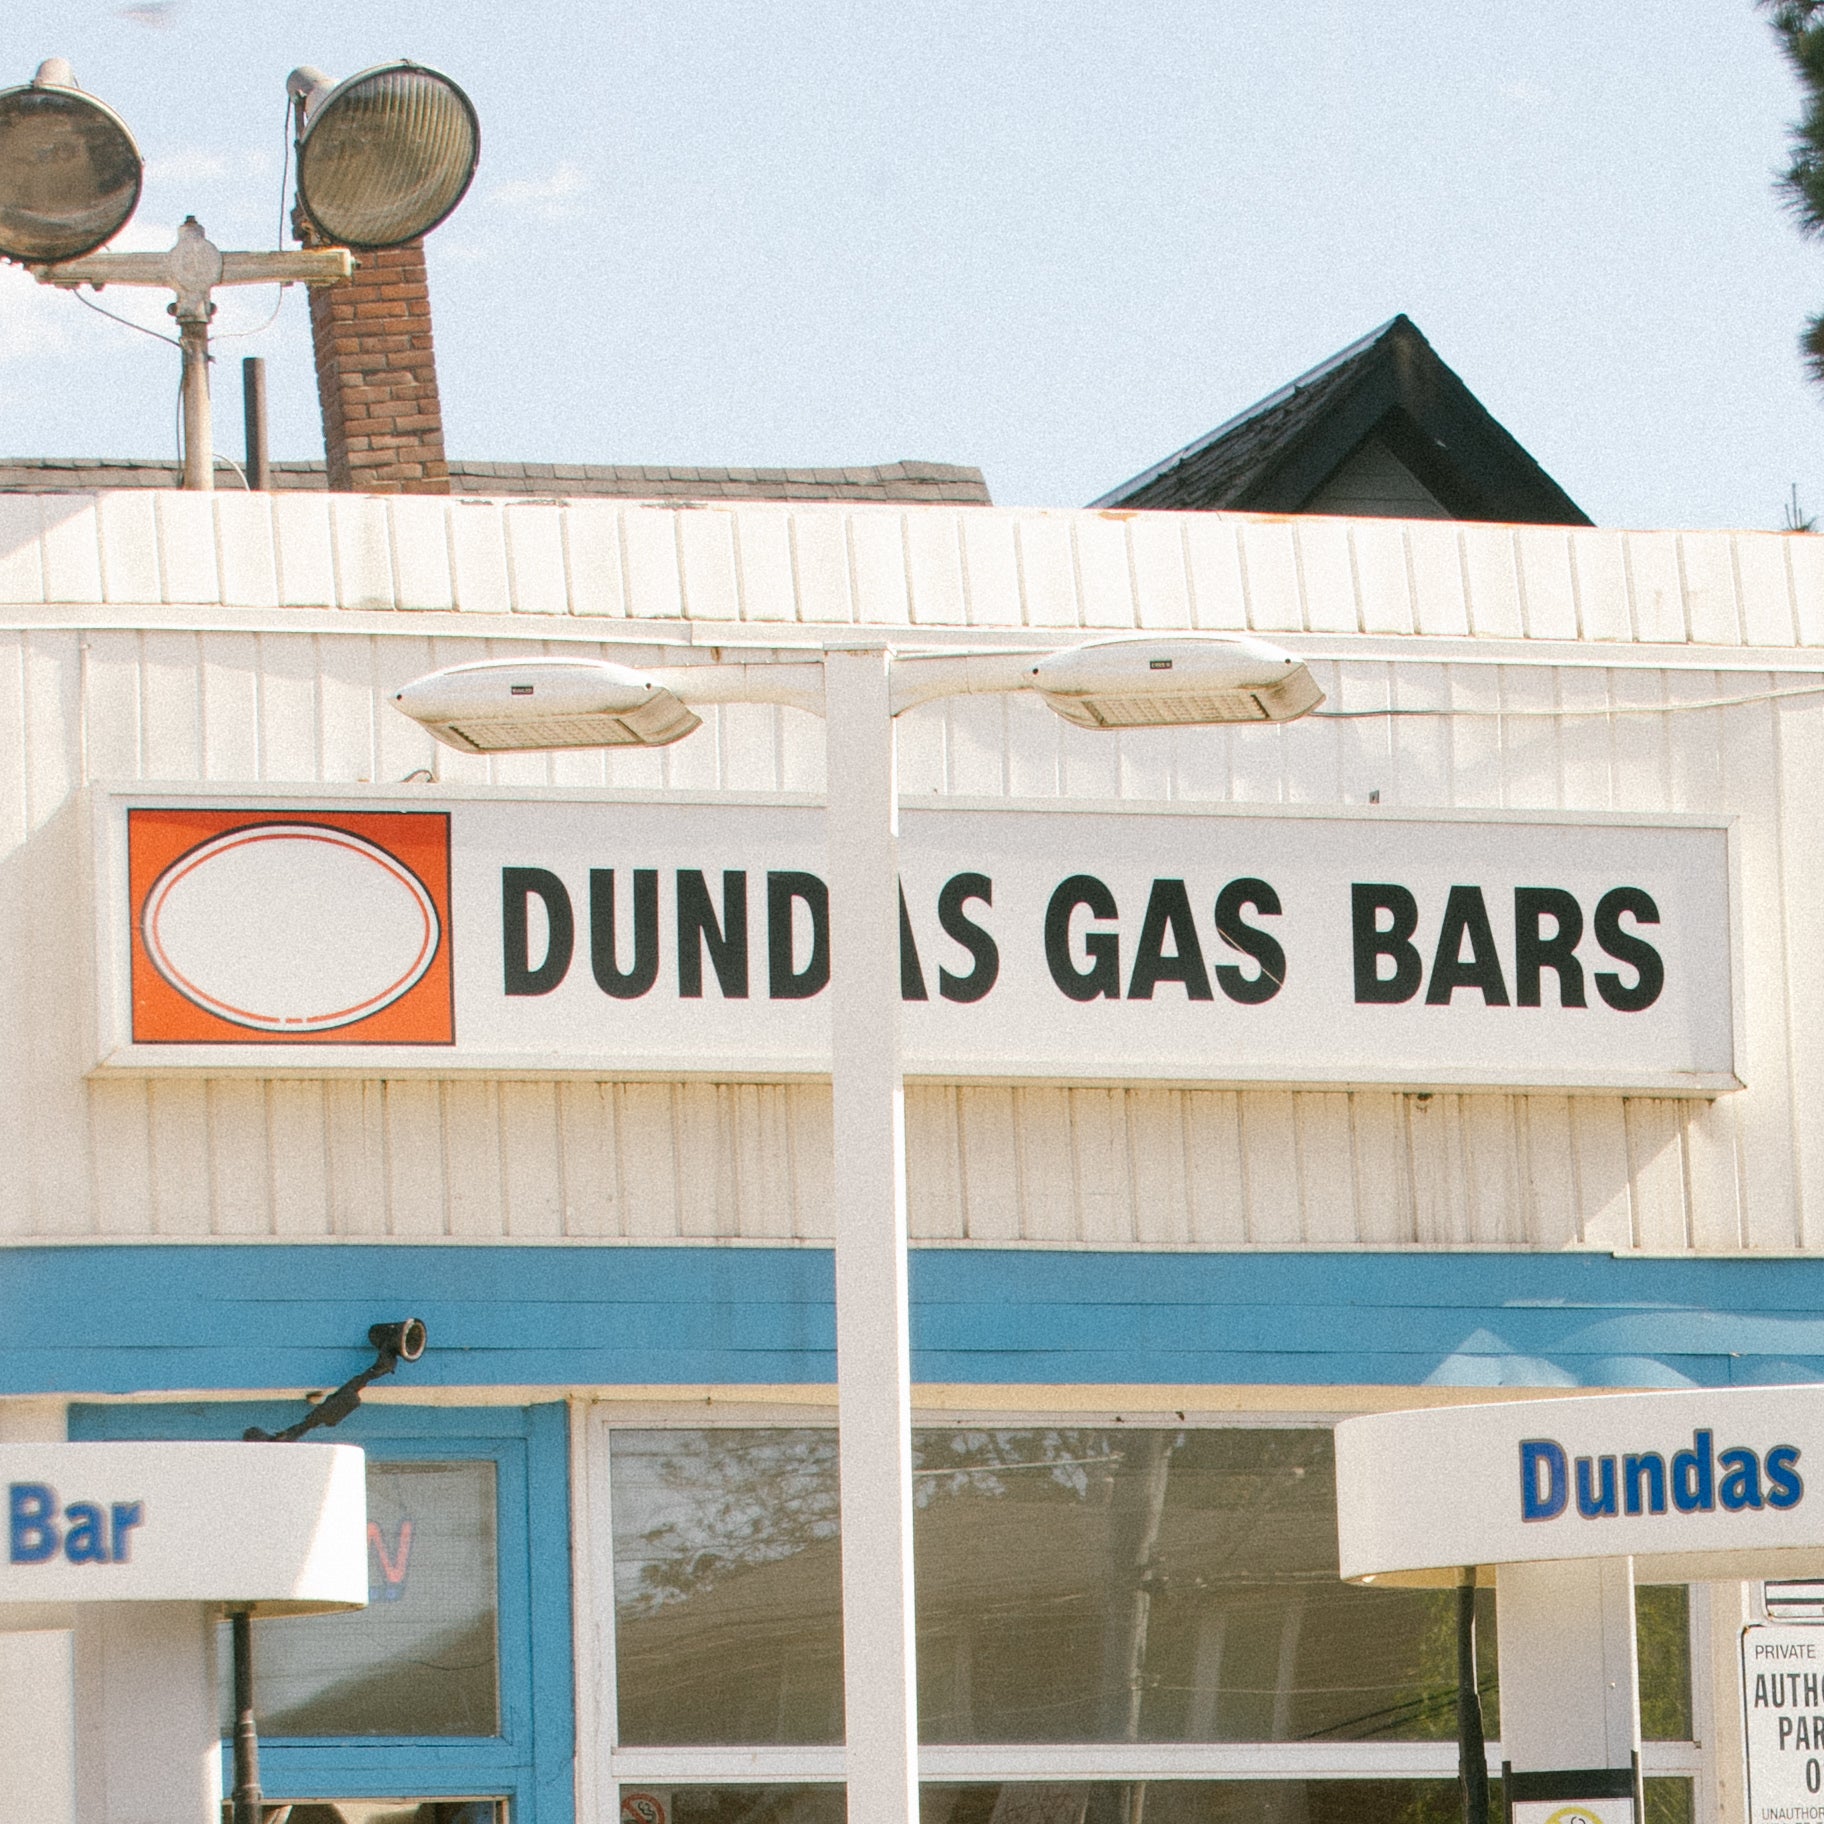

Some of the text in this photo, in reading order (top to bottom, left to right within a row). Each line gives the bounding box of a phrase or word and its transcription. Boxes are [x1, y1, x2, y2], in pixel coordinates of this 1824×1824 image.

[1044, 875, 1287, 1004] GAS
[1351, 882, 1666, 1012] BARS
[1519, 1428, 1804, 1523] Dundas
[8, 1481, 145, 1565] Bar
[1755, 1644, 1816, 1659] PRIVATE
